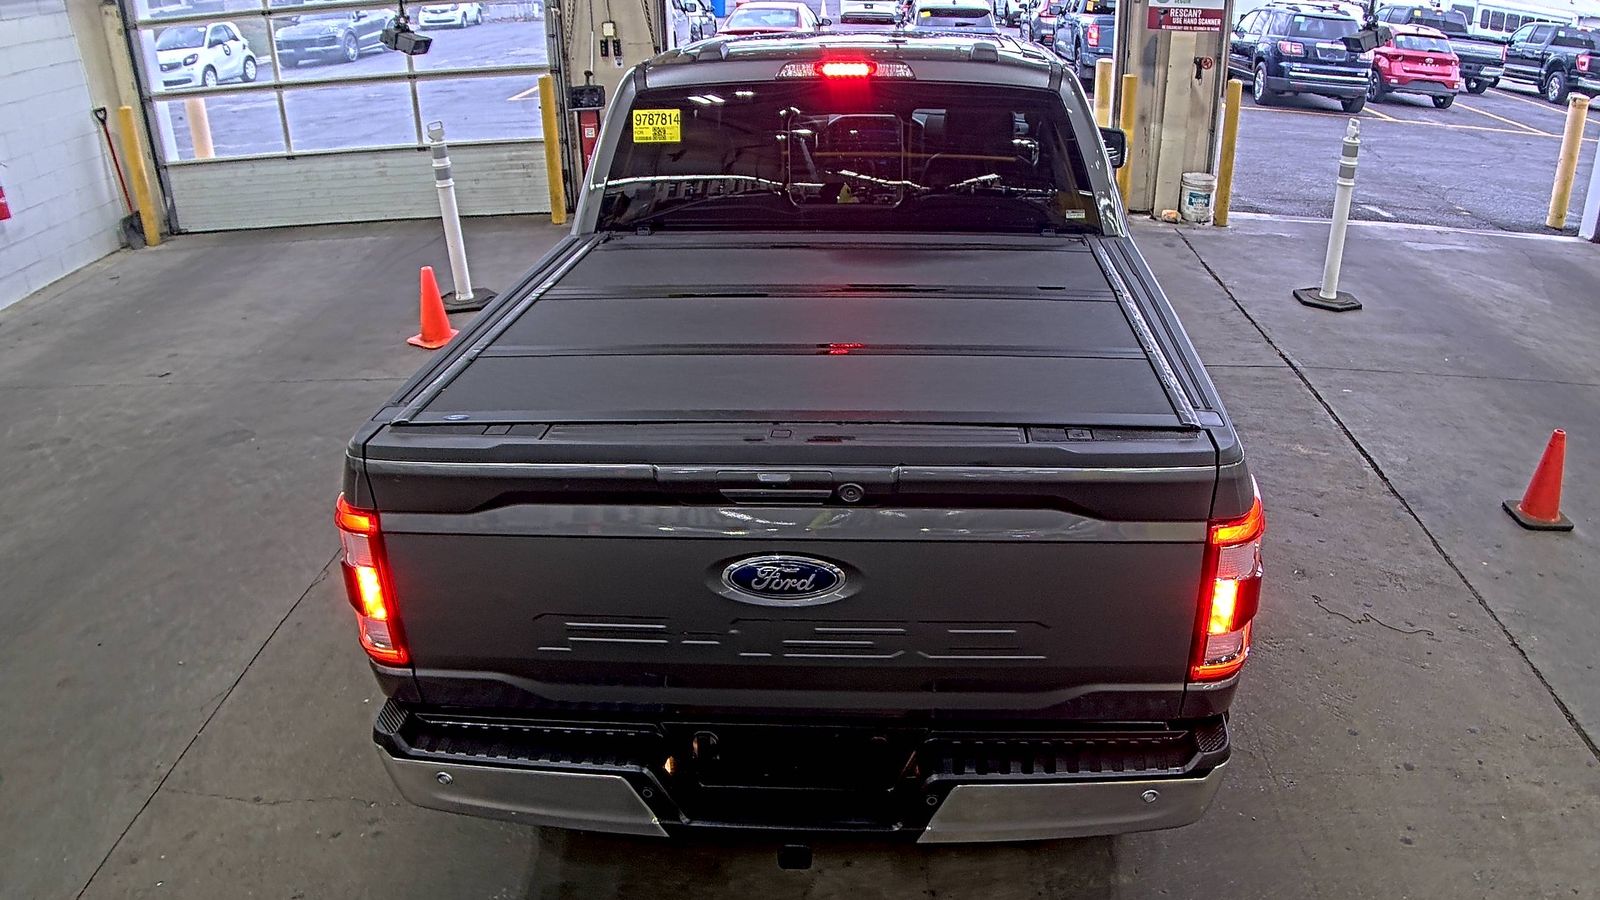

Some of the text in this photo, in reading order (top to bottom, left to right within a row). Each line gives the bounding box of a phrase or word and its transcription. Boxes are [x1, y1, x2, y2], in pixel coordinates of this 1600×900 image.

[1170, 8, 1202, 17] RESCAN?
[1183, 17, 1197, 25] HAND
[1198, 18, 1221, 26] SCANNER
[635, 113, 680, 126] 9787814
[751, 566, 816, 591] Ford
